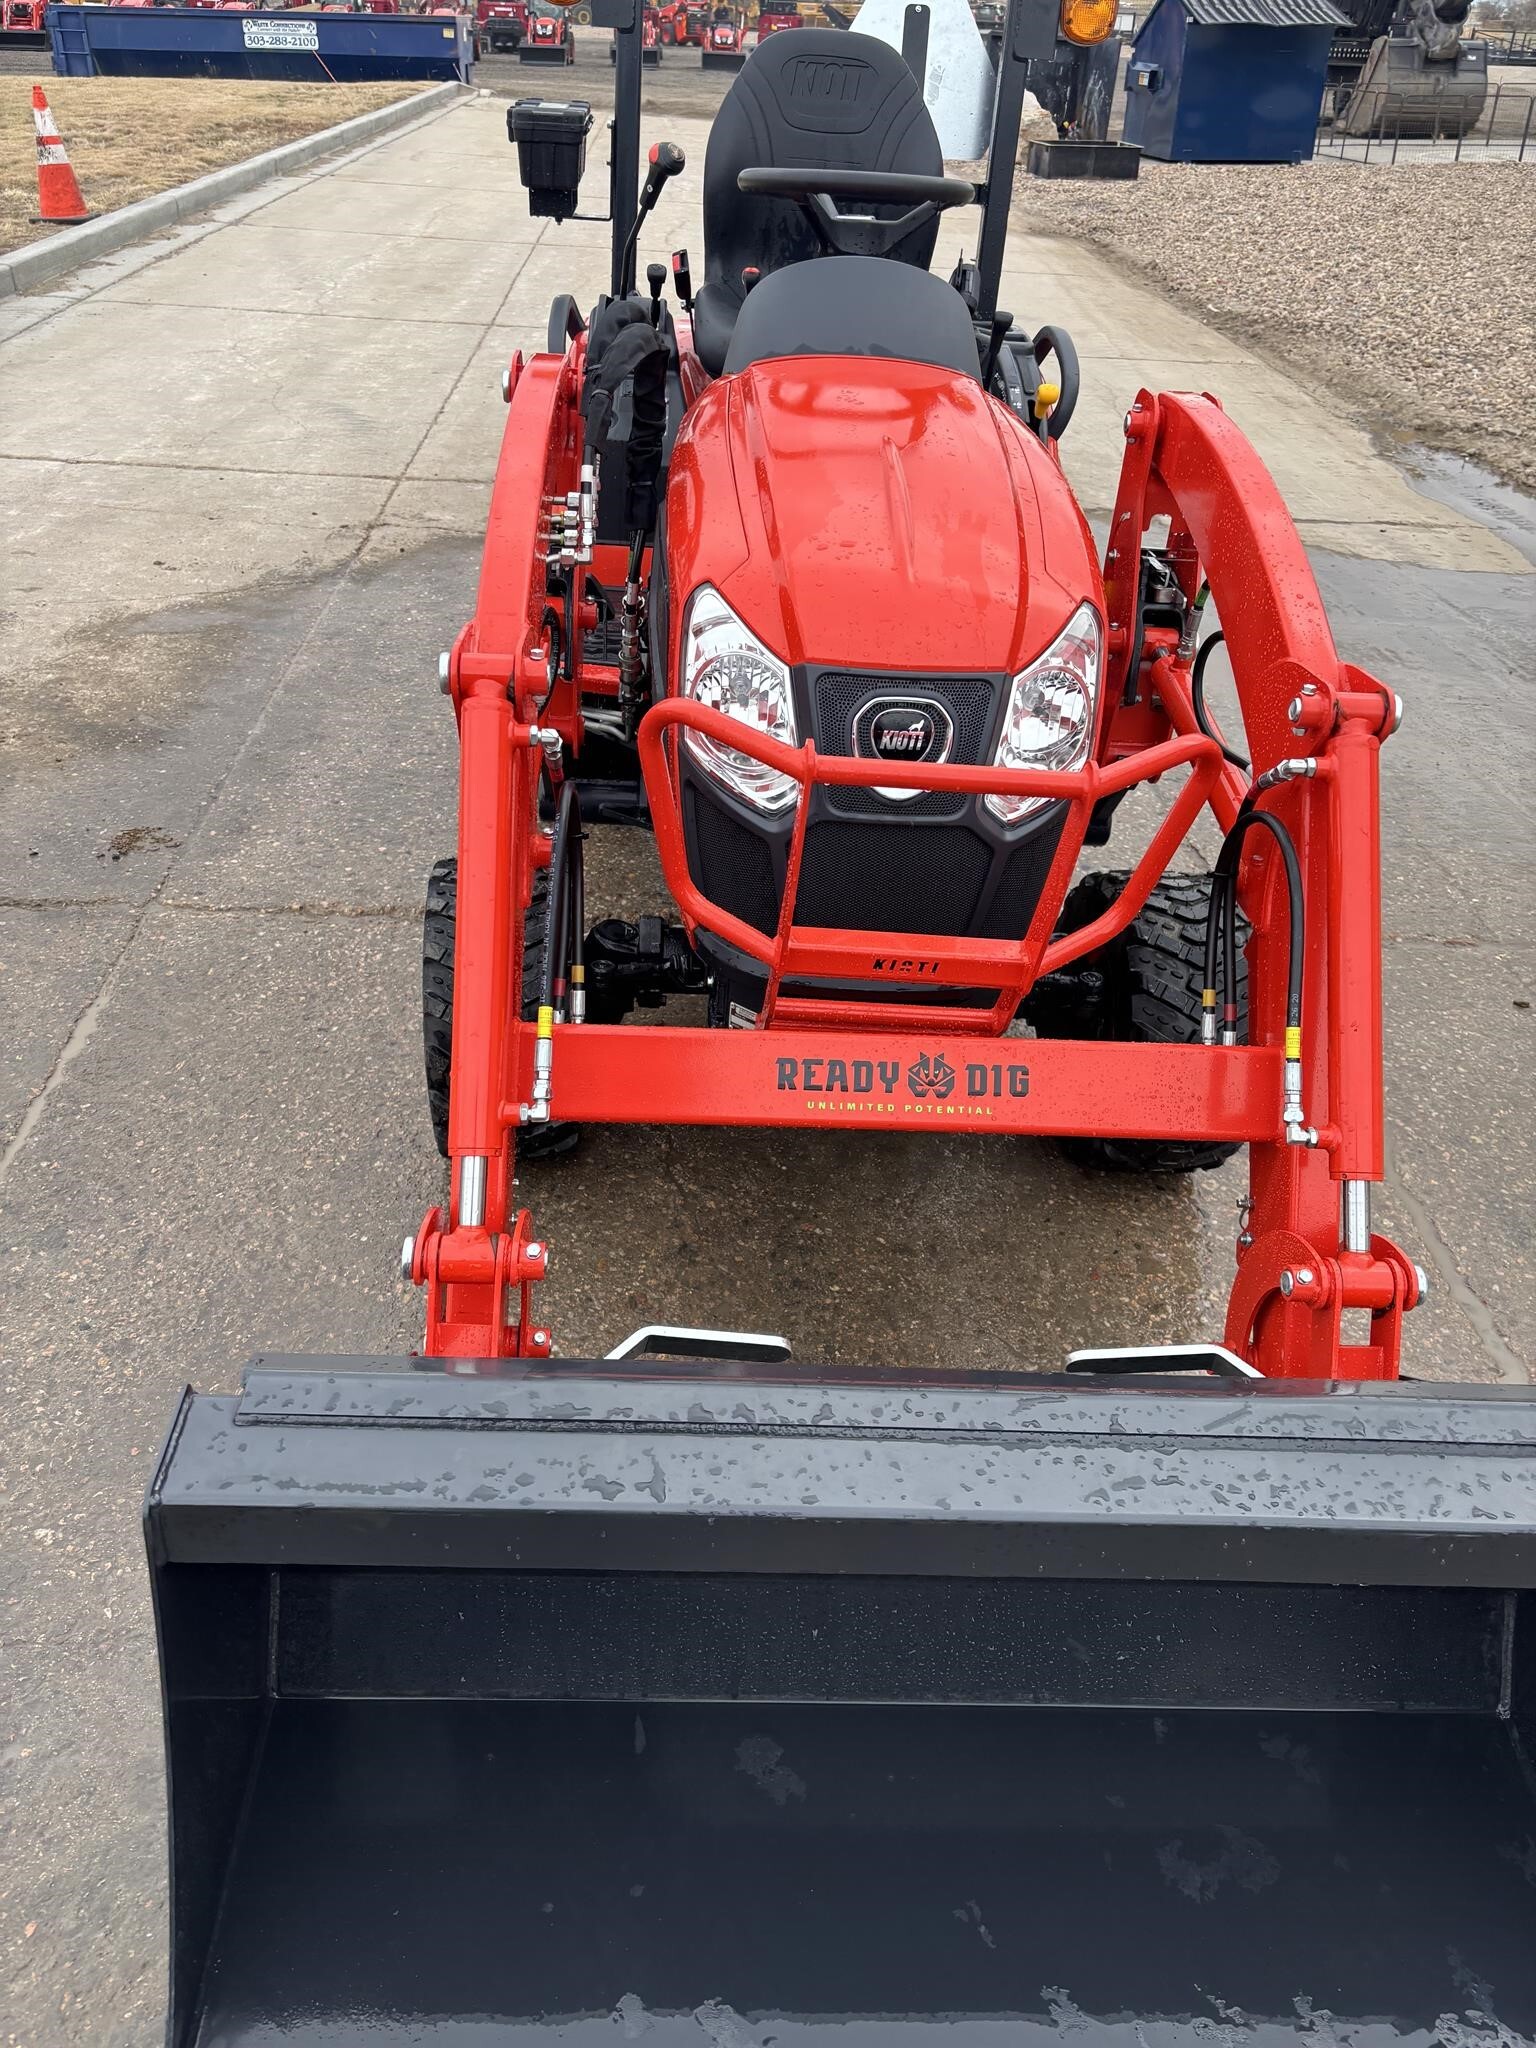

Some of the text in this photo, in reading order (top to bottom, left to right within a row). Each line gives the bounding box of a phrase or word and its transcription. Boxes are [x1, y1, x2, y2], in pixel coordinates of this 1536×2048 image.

[247, 35, 317, 47] 303-288-2100
[879, 729, 925, 751] KIOTI
[543, 936, 550, 947] IN
[872, 958, 940, 974] KIOTI
[775, 1057, 1030, 1098] READY DIG
[806, 1100, 993, 1116] UNLIMITED POTENTIAL
